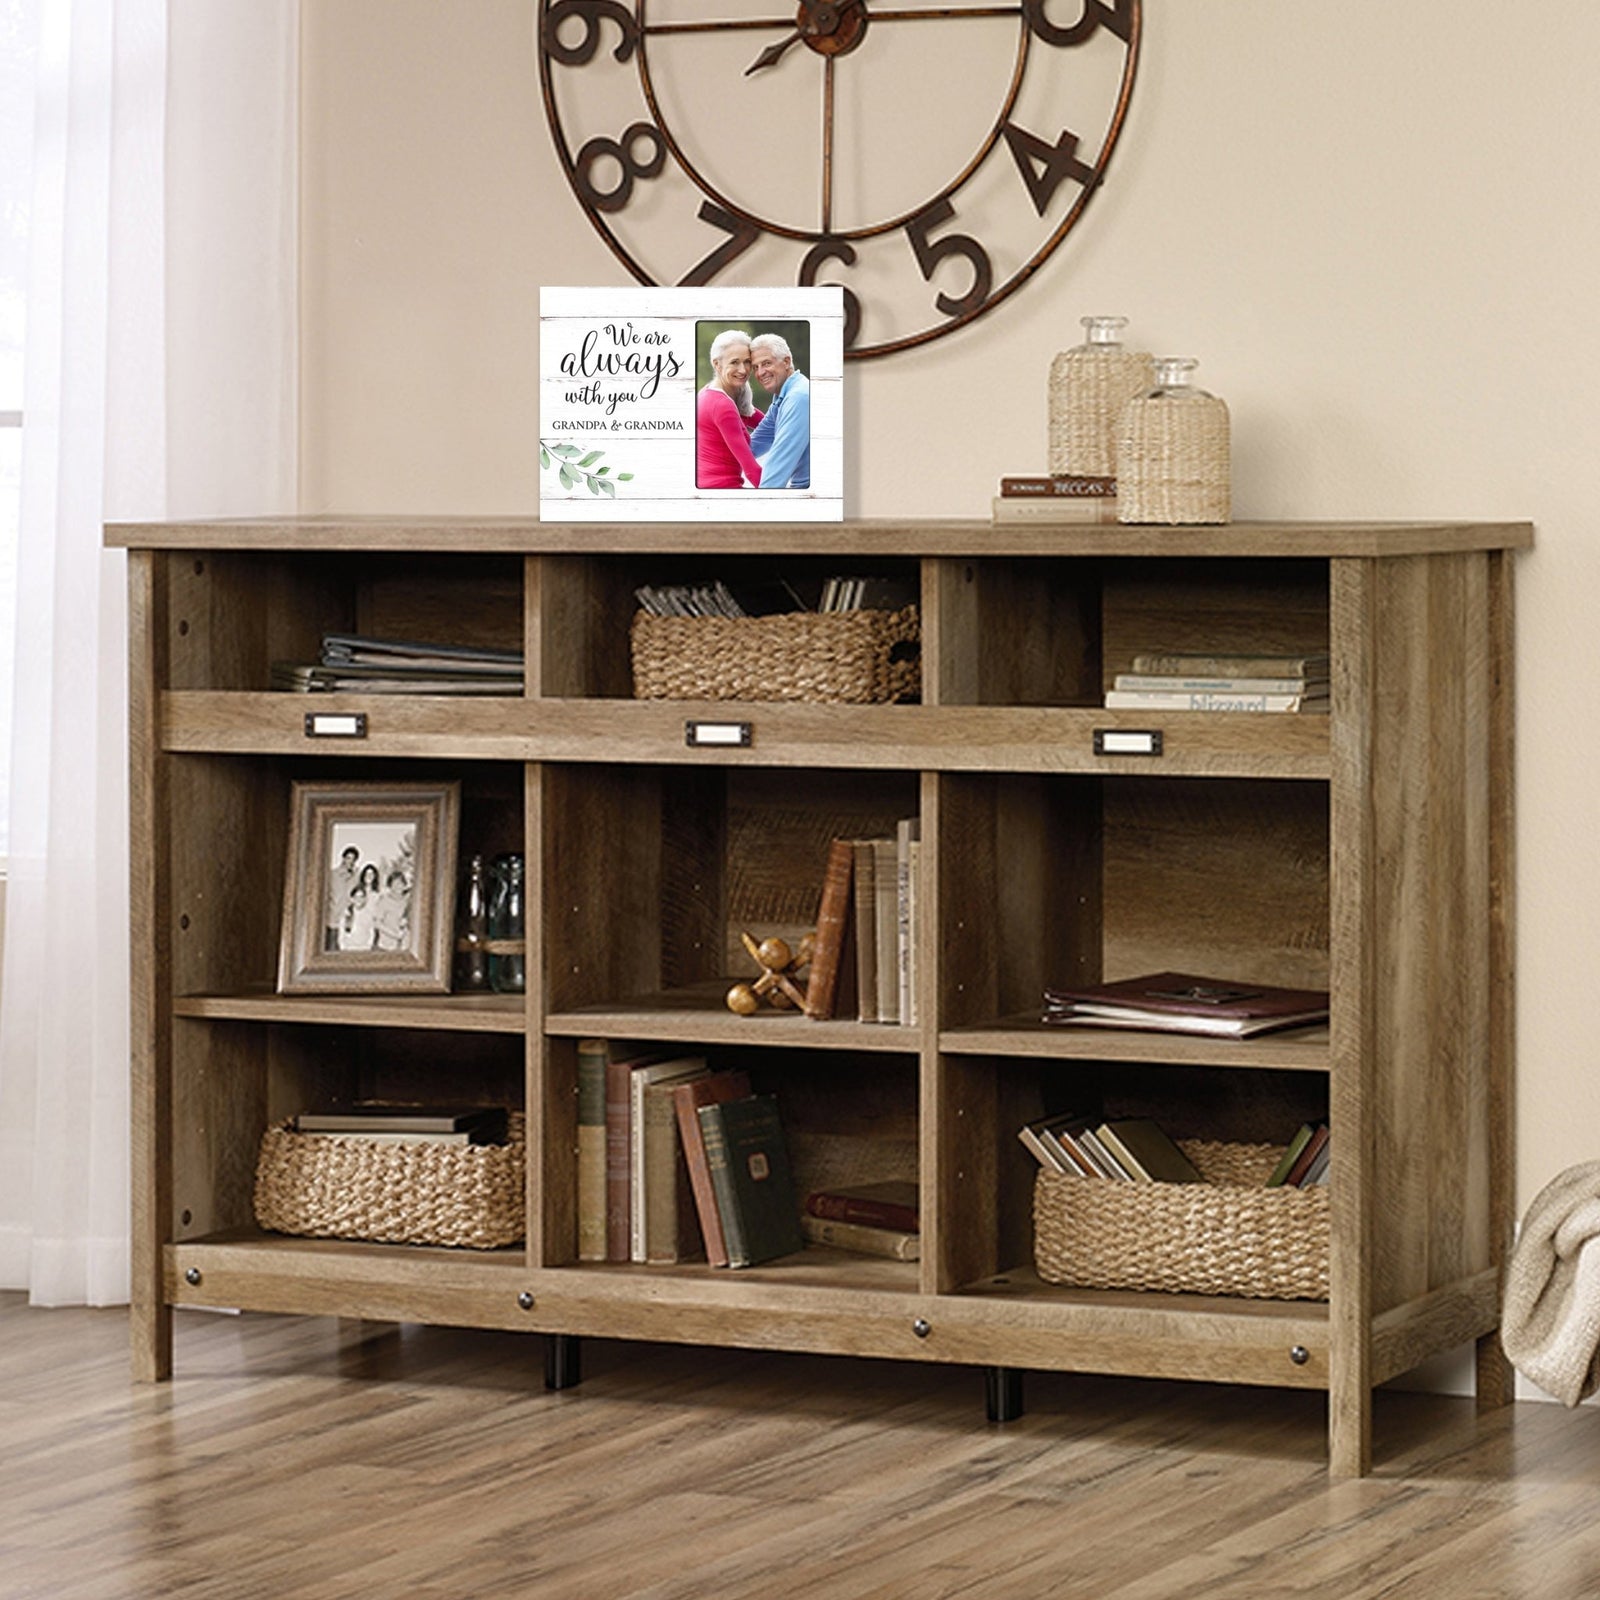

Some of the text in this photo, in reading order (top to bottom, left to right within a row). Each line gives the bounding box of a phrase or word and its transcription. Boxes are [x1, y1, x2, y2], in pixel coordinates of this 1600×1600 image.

[574, 121, 667, 213] 8
[1001, 120, 1103, 217] 4
[673, 200, 761, 287] 7
[904, 199, 993, 317] 5
[603, 322, 671, 347] We are
[799, 240, 862, 350] 6
[560, 330, 685, 400] always
[565, 380, 638, 416] with you
[552, 420, 684, 431] GRANDPA & GRANDMA
